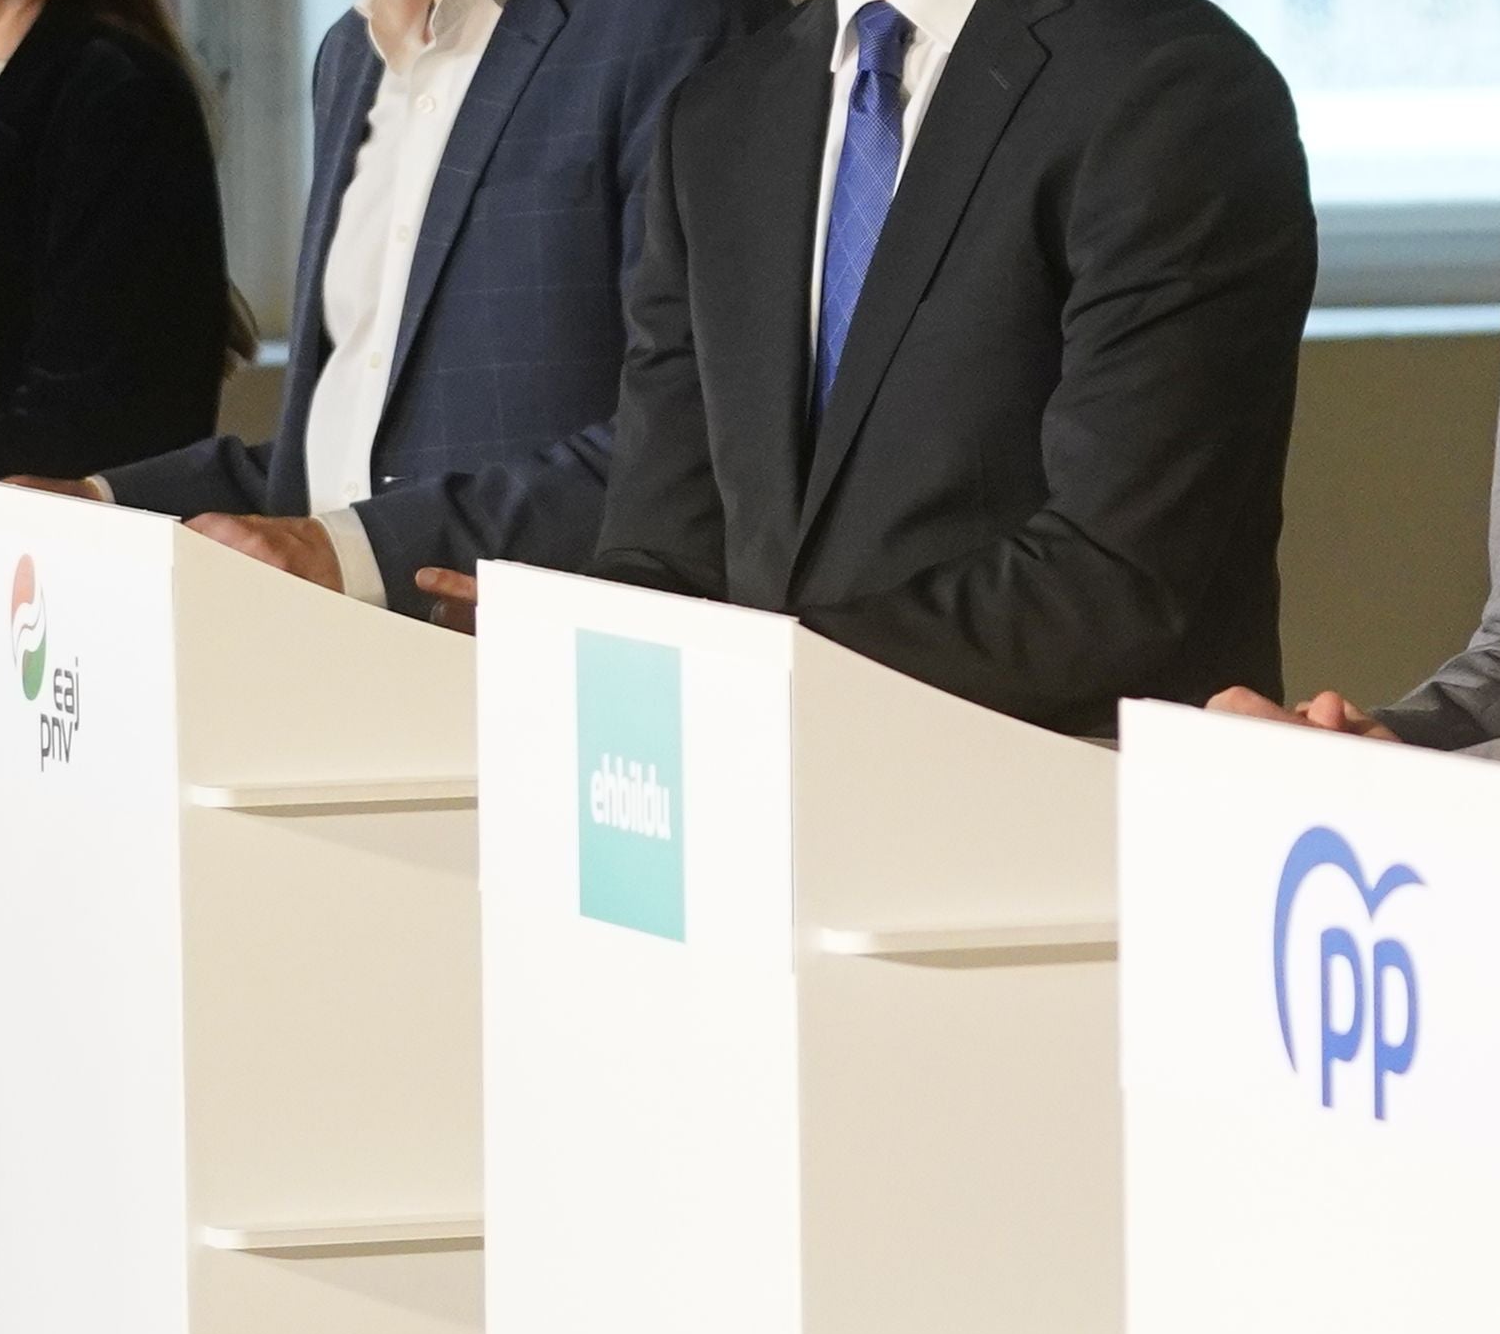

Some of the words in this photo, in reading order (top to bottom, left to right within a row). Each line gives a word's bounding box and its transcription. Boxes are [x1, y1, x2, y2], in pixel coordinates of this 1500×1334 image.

[53, 656, 79, 731] eaj
[40, 713, 73, 772] pnv
[590, 752, 672, 840] ehbildu
